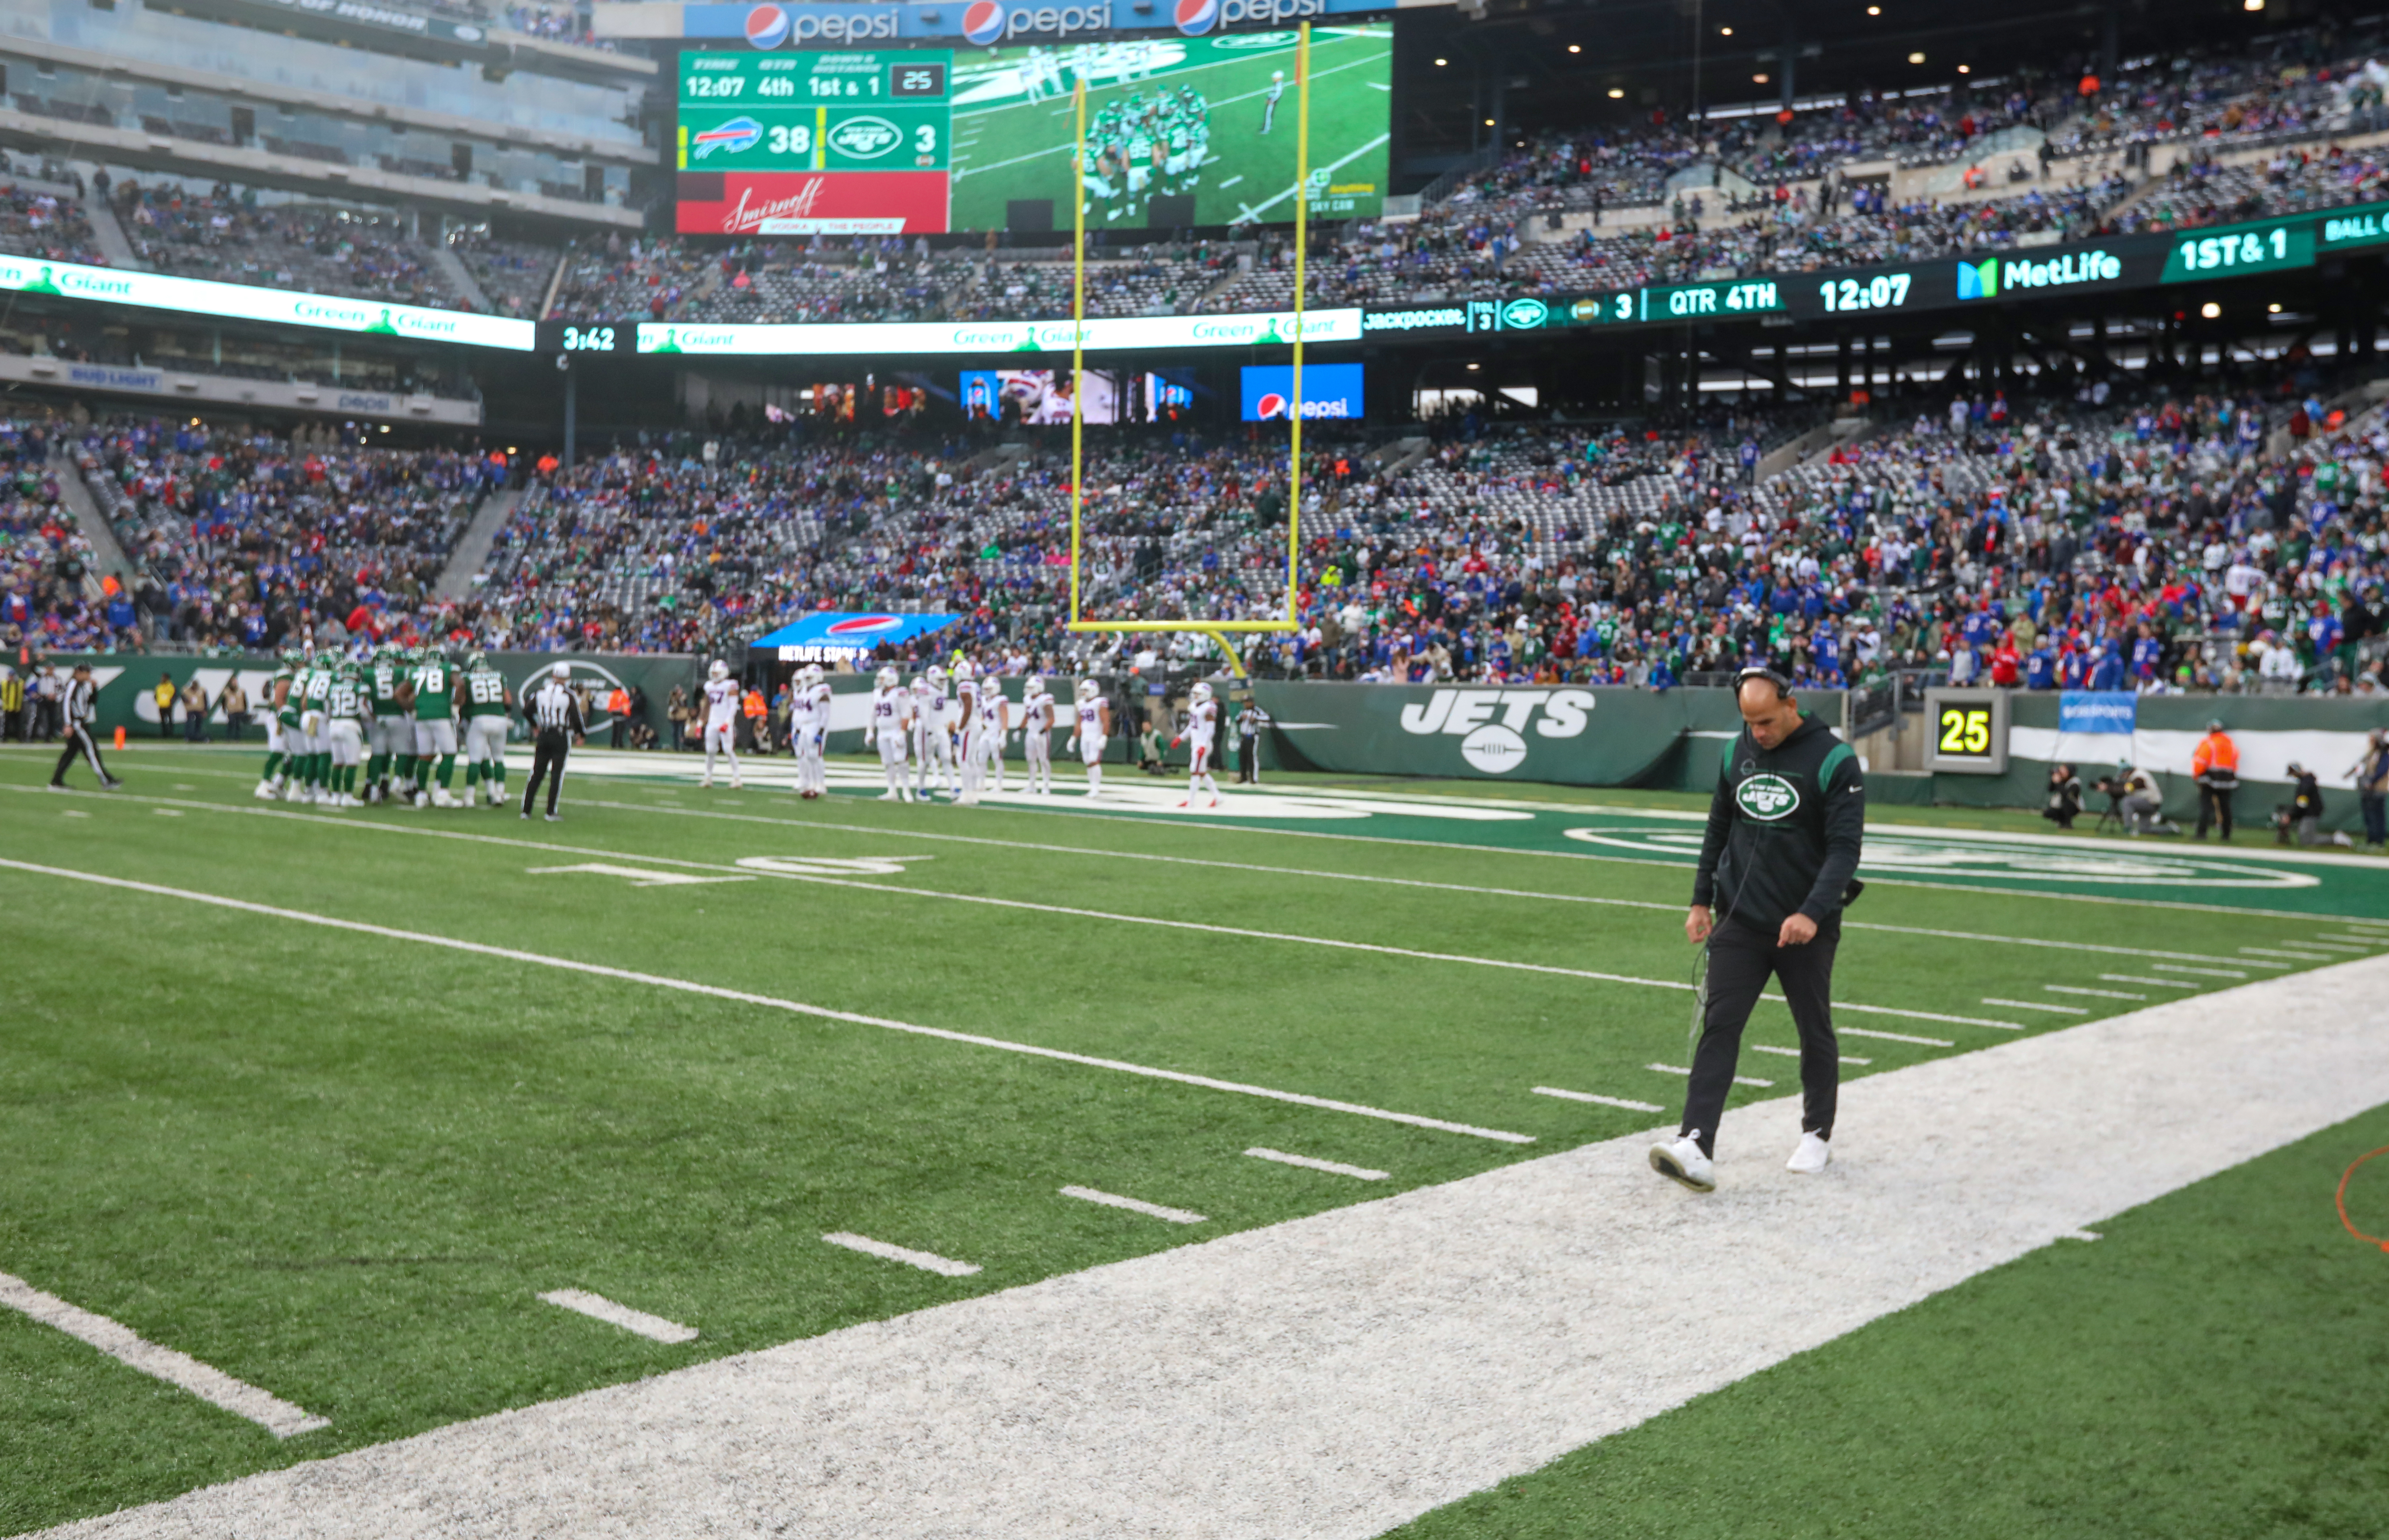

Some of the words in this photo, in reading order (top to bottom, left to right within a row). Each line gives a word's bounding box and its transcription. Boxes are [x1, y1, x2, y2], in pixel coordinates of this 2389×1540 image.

[336, 1, 427, 31] HONOR
[793, 9, 898, 45] pepsi
[1007, 0, 1112, 39] pepsi
[1220, 0, 1325, 30] pepsi
[687, 76, 745, 97] 12:07
[758, 76, 794, 96] 4th
[808, 76, 841, 96] 1st
[845, 81, 859, 96] &
[868, 76, 880, 96] 1
[902, 70, 933, 90] 25
[768, 125, 810, 154] 38
[915, 124, 936, 153] 3
[723, 176, 825, 234] Smirnoff
[2325, 214, 2380, 242] BALL
[2003, 249, 2122, 290] MetLife
[61, 272, 132, 295] Giant
[1819, 273, 1911, 312] 12:07
[1615, 293, 1633, 319] 3
[1669, 288, 1717, 315] QTR
[1725, 282, 1777, 310] 4TH
[295, 300, 365, 322] Green
[398, 312, 457, 333] Giant
[1478, 313, 1492, 331] 3
[563, 327, 615, 351] 3:42
[682, 330, 735, 346] Giant
[954, 329, 1013, 345] Green
[1192, 322, 1254, 339] Green
[72, 369, 106, 383] BUD
[109, 372, 156, 388] LIGHT
[778, 645, 822, 662] METLIFE
[376, 675, 394, 699] 5
[411, 669, 443, 696] 78
[471, 680, 503, 703] 62
[875, 703, 892, 716] 99
[1401, 689, 1596, 738] JETS
[1940, 709, 1989, 752] 25
[1742, 790, 1791, 806] JETS
[1767, 785, 1787, 794] YORK
